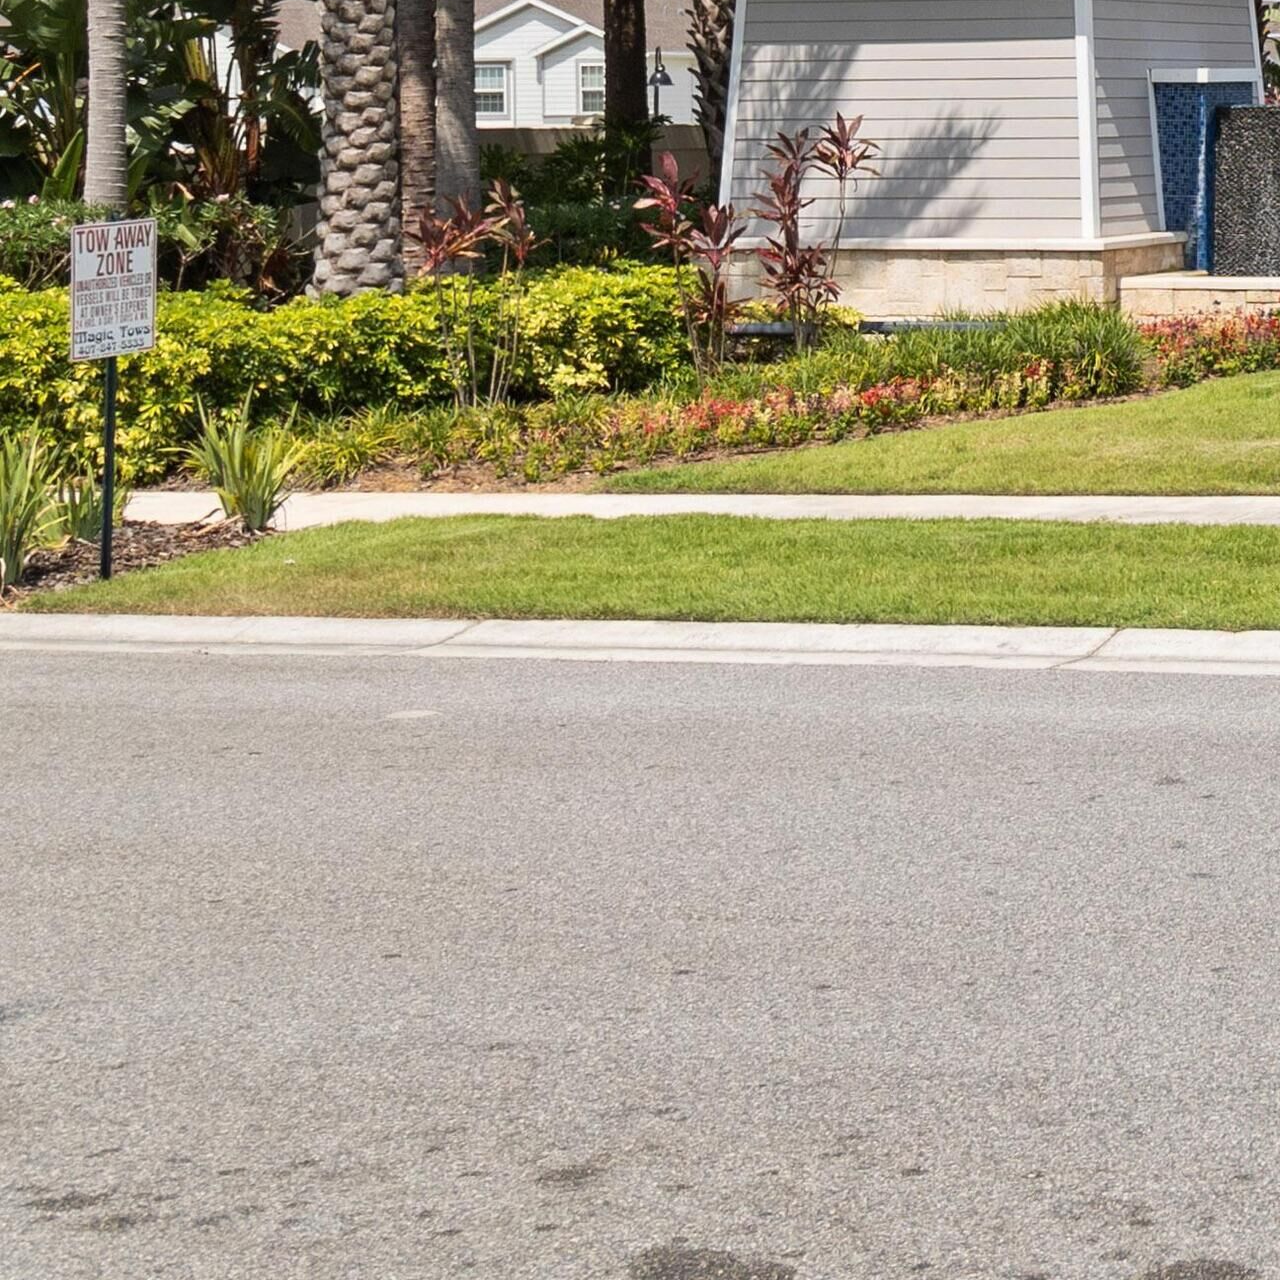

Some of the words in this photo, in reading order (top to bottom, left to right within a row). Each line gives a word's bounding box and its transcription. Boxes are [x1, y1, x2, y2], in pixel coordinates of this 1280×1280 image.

[76, 228, 110, 254] TOW
[114, 223, 152, 250] AWAY
[96, 250, 134, 277] ZONE
[76, 290, 104, 306] VESSELS
[105, 289, 120, 302] WILL
[121, 288, 130, 300] BE
[131, 286, 152, 299] TOWED
[80, 306, 88, 318] AT
[90, 303, 119, 318] OWNER'S
[120, 299, 148, 313] EXPENSE
[75, 329, 114, 344] Magic
[119, 325, 151, 338] Tows
